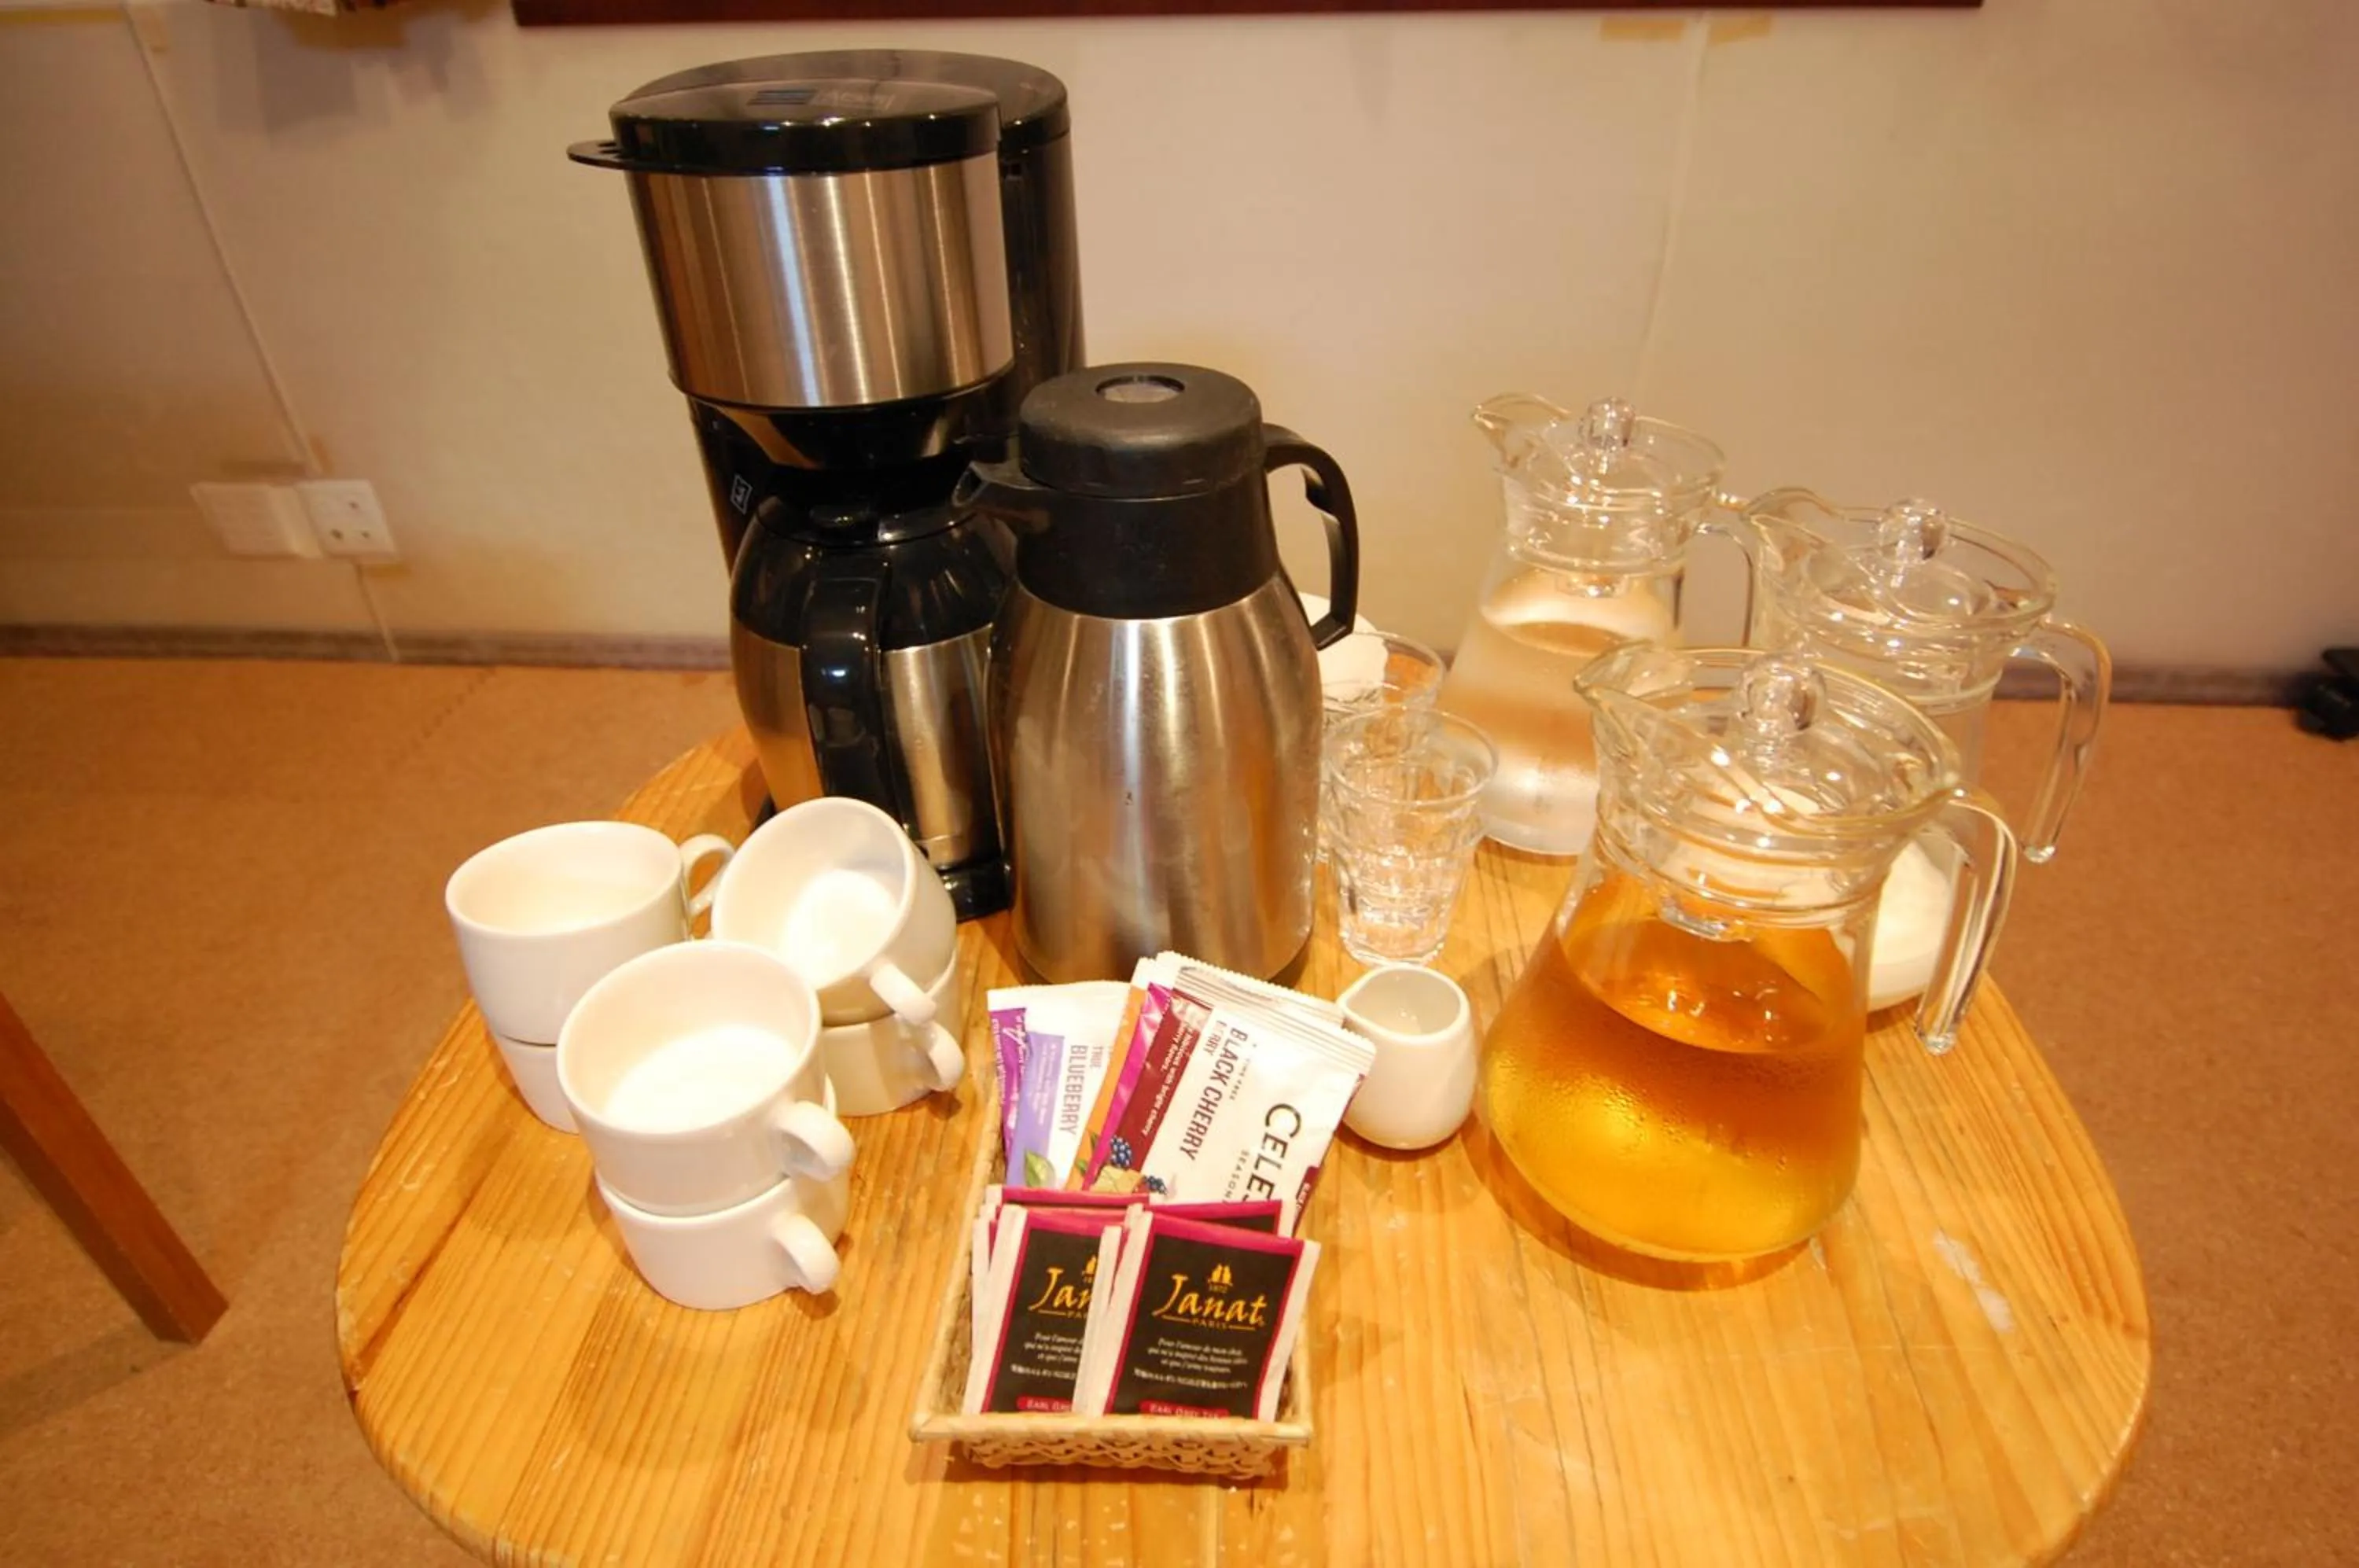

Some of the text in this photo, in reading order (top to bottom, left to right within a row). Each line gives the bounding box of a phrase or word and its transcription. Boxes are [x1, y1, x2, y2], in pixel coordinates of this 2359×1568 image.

[1203, 1020, 1227, 1056] RRY
[1209, 1027, 1249, 1087] BLACK
[1058, 1044, 1088, 1135] BLUEBERRY
[1180, 1085, 1224, 1161] CHERRY
[1242, 1103, 1302, 1202] CELE
[1222, 1150, 1249, 1205] SEASON
[1151, 1273, 1267, 1325] Janat
